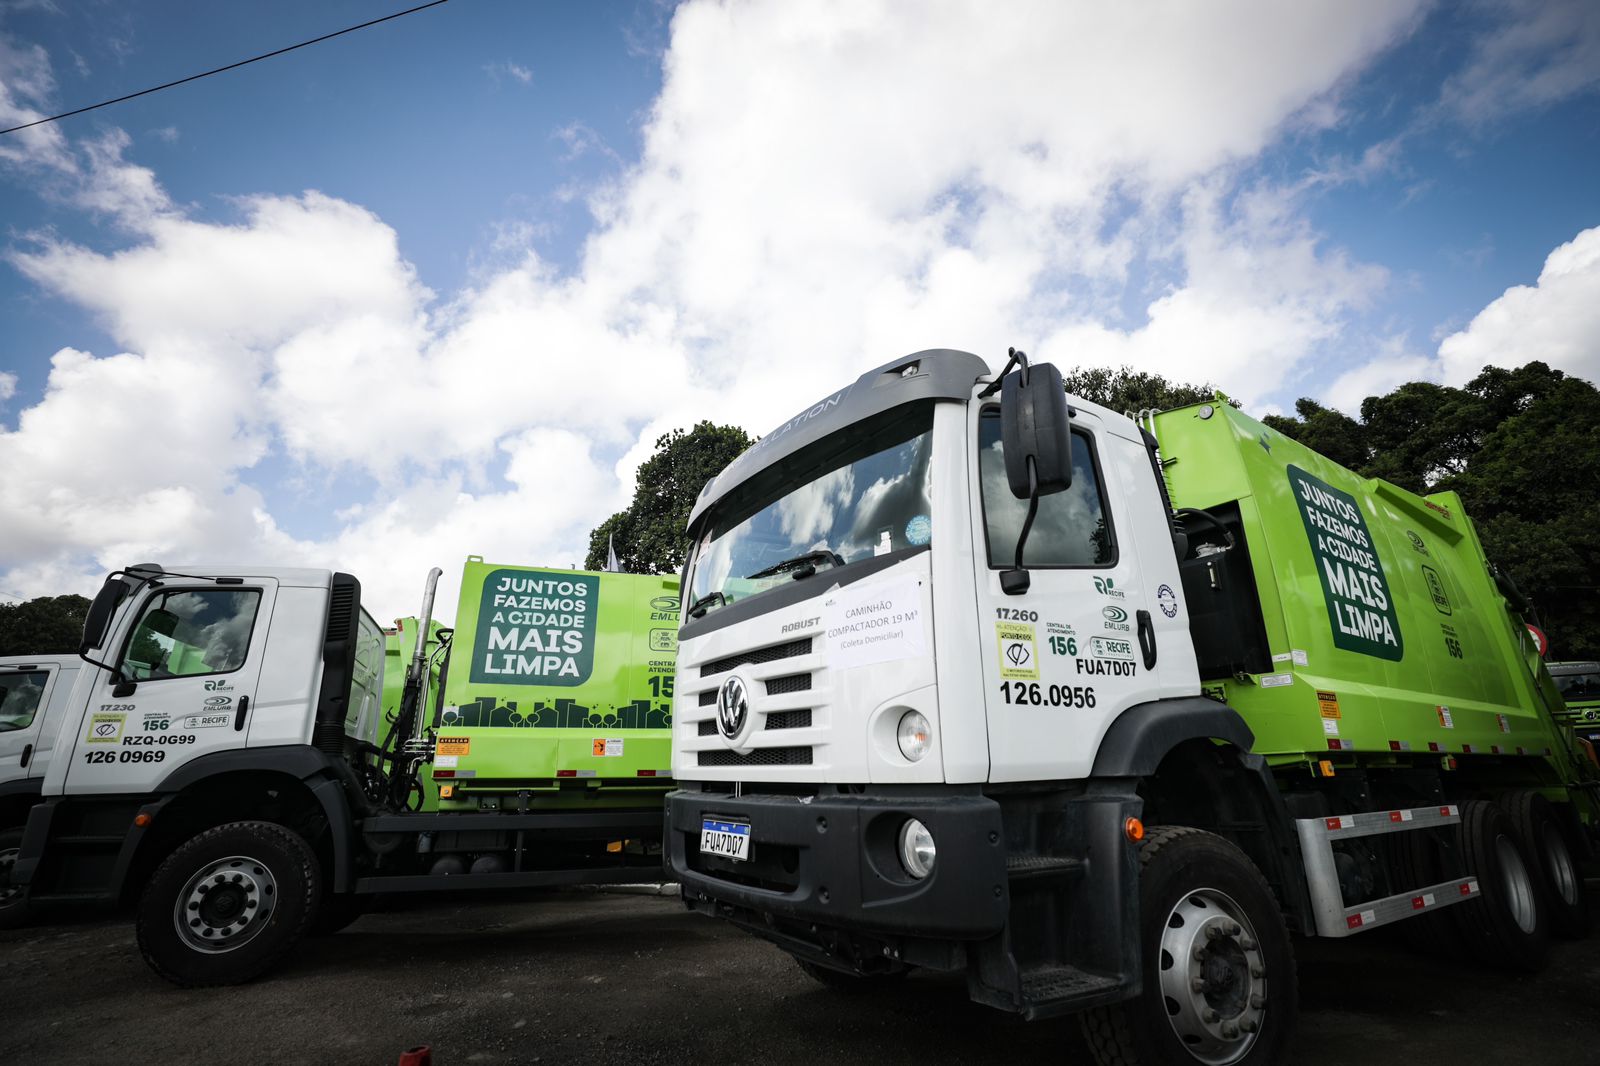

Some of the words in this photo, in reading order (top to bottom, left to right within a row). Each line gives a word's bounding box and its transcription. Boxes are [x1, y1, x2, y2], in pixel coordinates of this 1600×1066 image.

[1298, 479, 1360, 525] JUNTOS
[1306, 505, 1369, 548] FAZEMOS
[1318, 534, 1328, 553] A
[1328, 537, 1378, 572] CIDADE
[496, 577, 588, 597] JUNTOS
[1322, 556, 1388, 611] MAIS
[493, 595, 586, 613] FAZEMOS
[845, 600, 893, 619] CAMINHÃO
[492, 612, 505, 623] A
[508, 612, 585, 628] CIDADE
[996, 607, 1038, 622] 17.260
[1334, 600, 1398, 647] LIMPA
[781, 616, 821, 634] ROBUST
[828, 618, 889, 639] COMPACTADOR
[892, 615, 902, 625] 19
[1047, 628, 1076, 636] ATENDIMENTO
[1104, 621, 1130, 632] EMLURB
[487, 626, 583, 654] MAIS
[840, 639, 864, 650] (Coleta
[865, 630, 904, 645] Domiciliar)
[1048, 635, 1077, 656] 156
[1106, 641, 1131, 654] RECIFE
[1445, 637, 1463, 659] 156
[484, 653, 580, 677] LIMPA
[1076, 658, 1136, 677] FUA7D07
[1000, 681, 1096, 709] 126.0956
[142, 719, 170, 731] 156
[122, 735, 196, 746] RZQ-0G99
[85, 751, 116, 764] 126
[119, 750, 165, 763] 0969
[704, 831, 744, 856] FUA7D07
